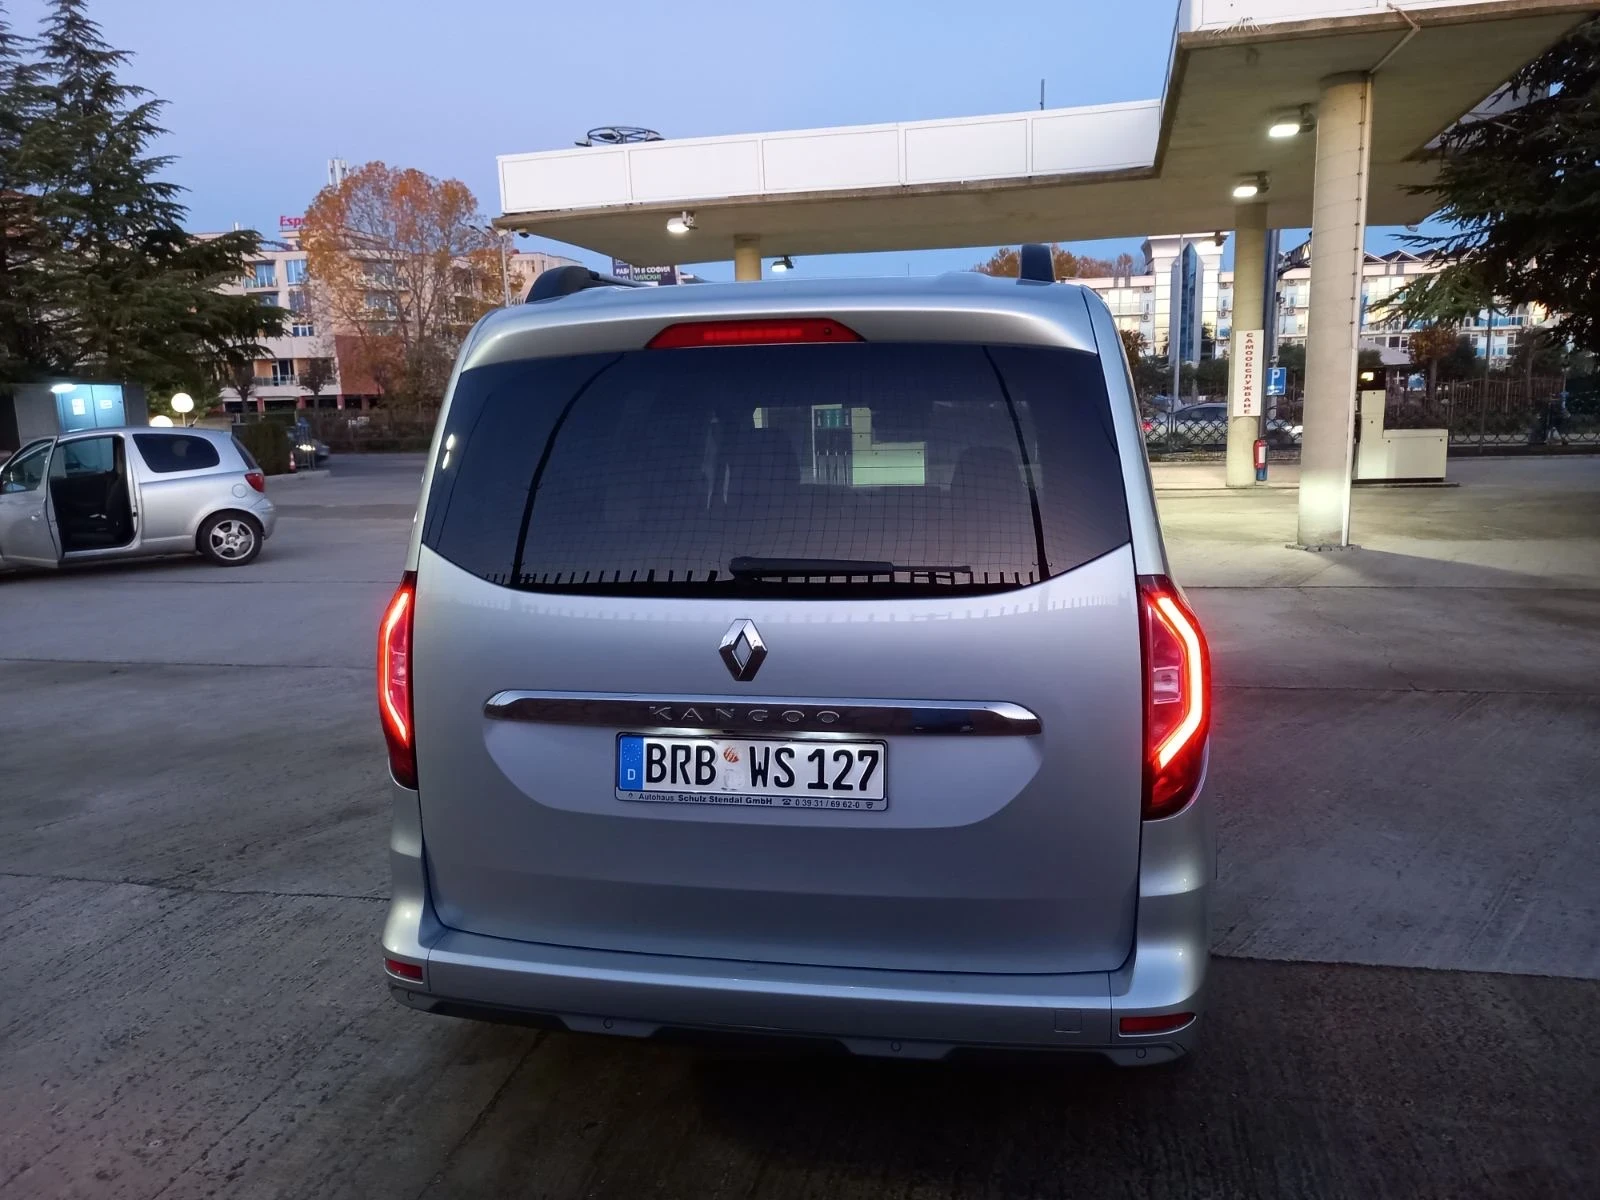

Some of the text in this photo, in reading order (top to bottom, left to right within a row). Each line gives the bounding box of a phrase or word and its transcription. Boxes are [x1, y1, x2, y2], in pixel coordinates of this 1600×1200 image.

[649, 706, 840, 723] KANGOO
[627, 768, 636, 781] D
[645, 743, 879, 791] BRB WS 127
[638, 793, 675, 802] Autohaus
[678, 794, 707, 803] Schulz
[709, 795, 743, 804] Stendal
[745, 797, 773, 805] GmbH
